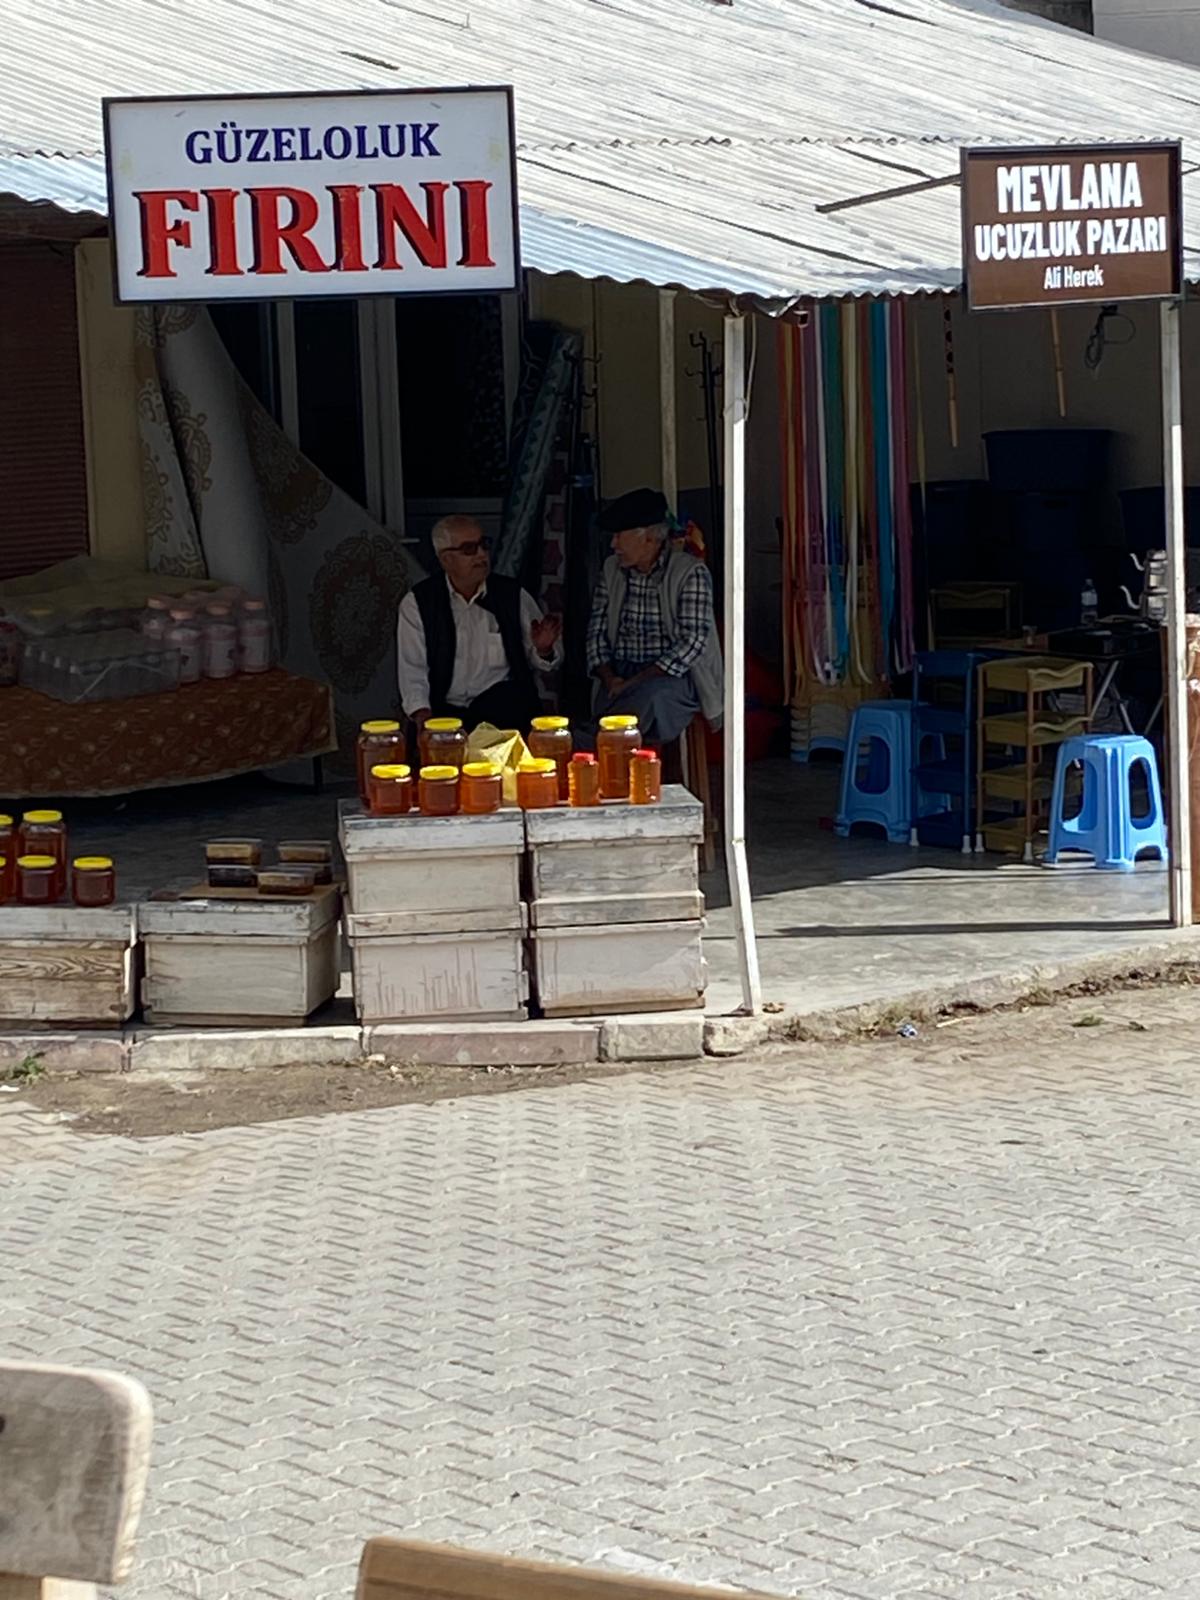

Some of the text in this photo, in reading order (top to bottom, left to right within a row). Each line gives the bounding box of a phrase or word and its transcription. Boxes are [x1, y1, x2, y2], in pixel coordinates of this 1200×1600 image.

[185, 122, 441, 164] GÜZELOLUK
[997, 162, 1143, 213] MEVLANA
[132, 180, 496, 278] FIRINI
[974, 216, 1167, 261] UCUZLUK PAZARI
[1044, 264, 1104, 289] Ali Herek
